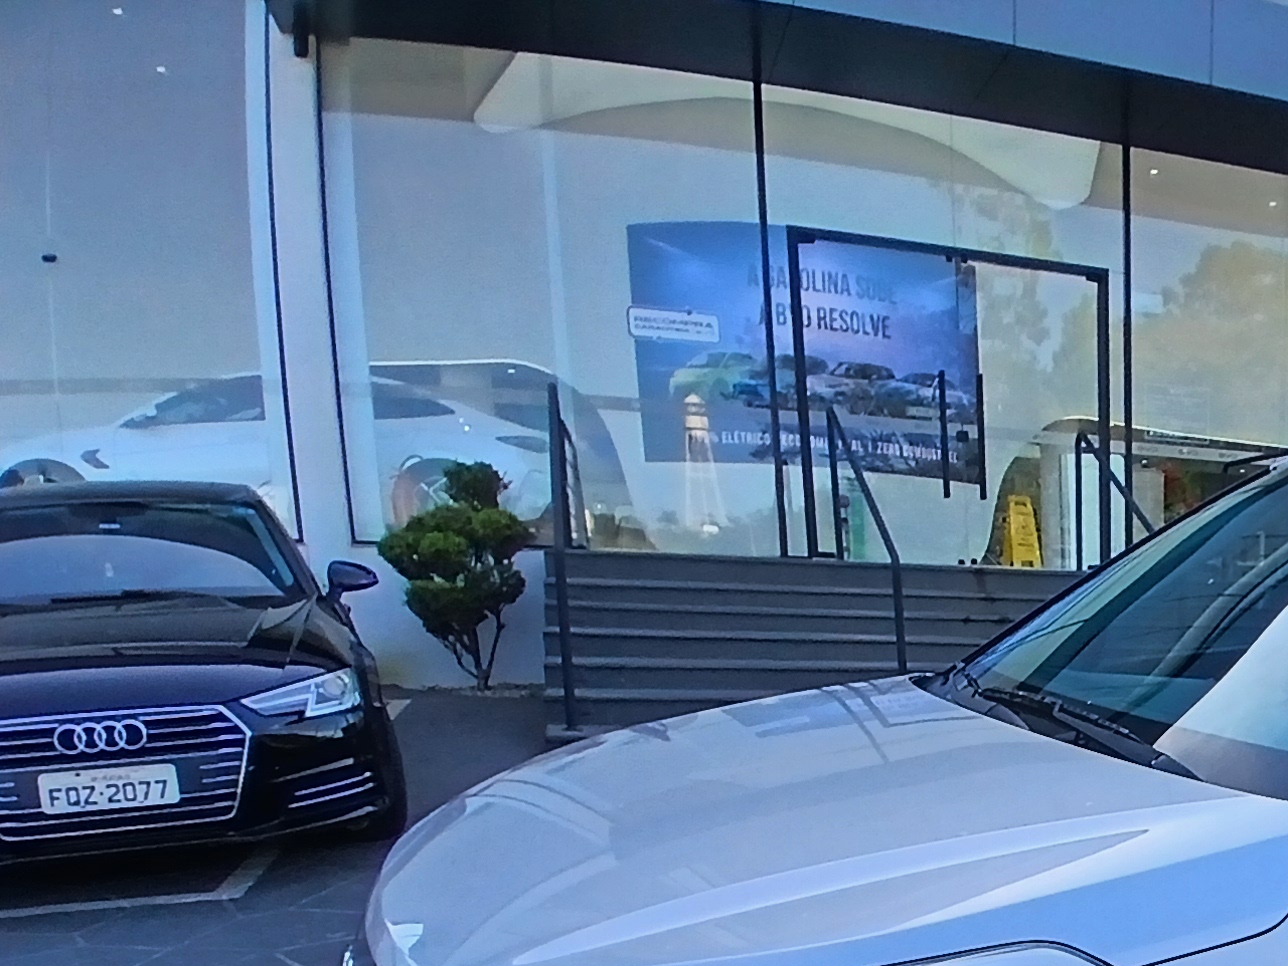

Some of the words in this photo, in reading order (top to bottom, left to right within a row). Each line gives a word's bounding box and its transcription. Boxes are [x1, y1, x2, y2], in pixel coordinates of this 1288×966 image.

[769, 264, 852, 297] AOLINA
[774, 301, 812, 328] BD
[816, 306, 892, 339] RESOLVE
